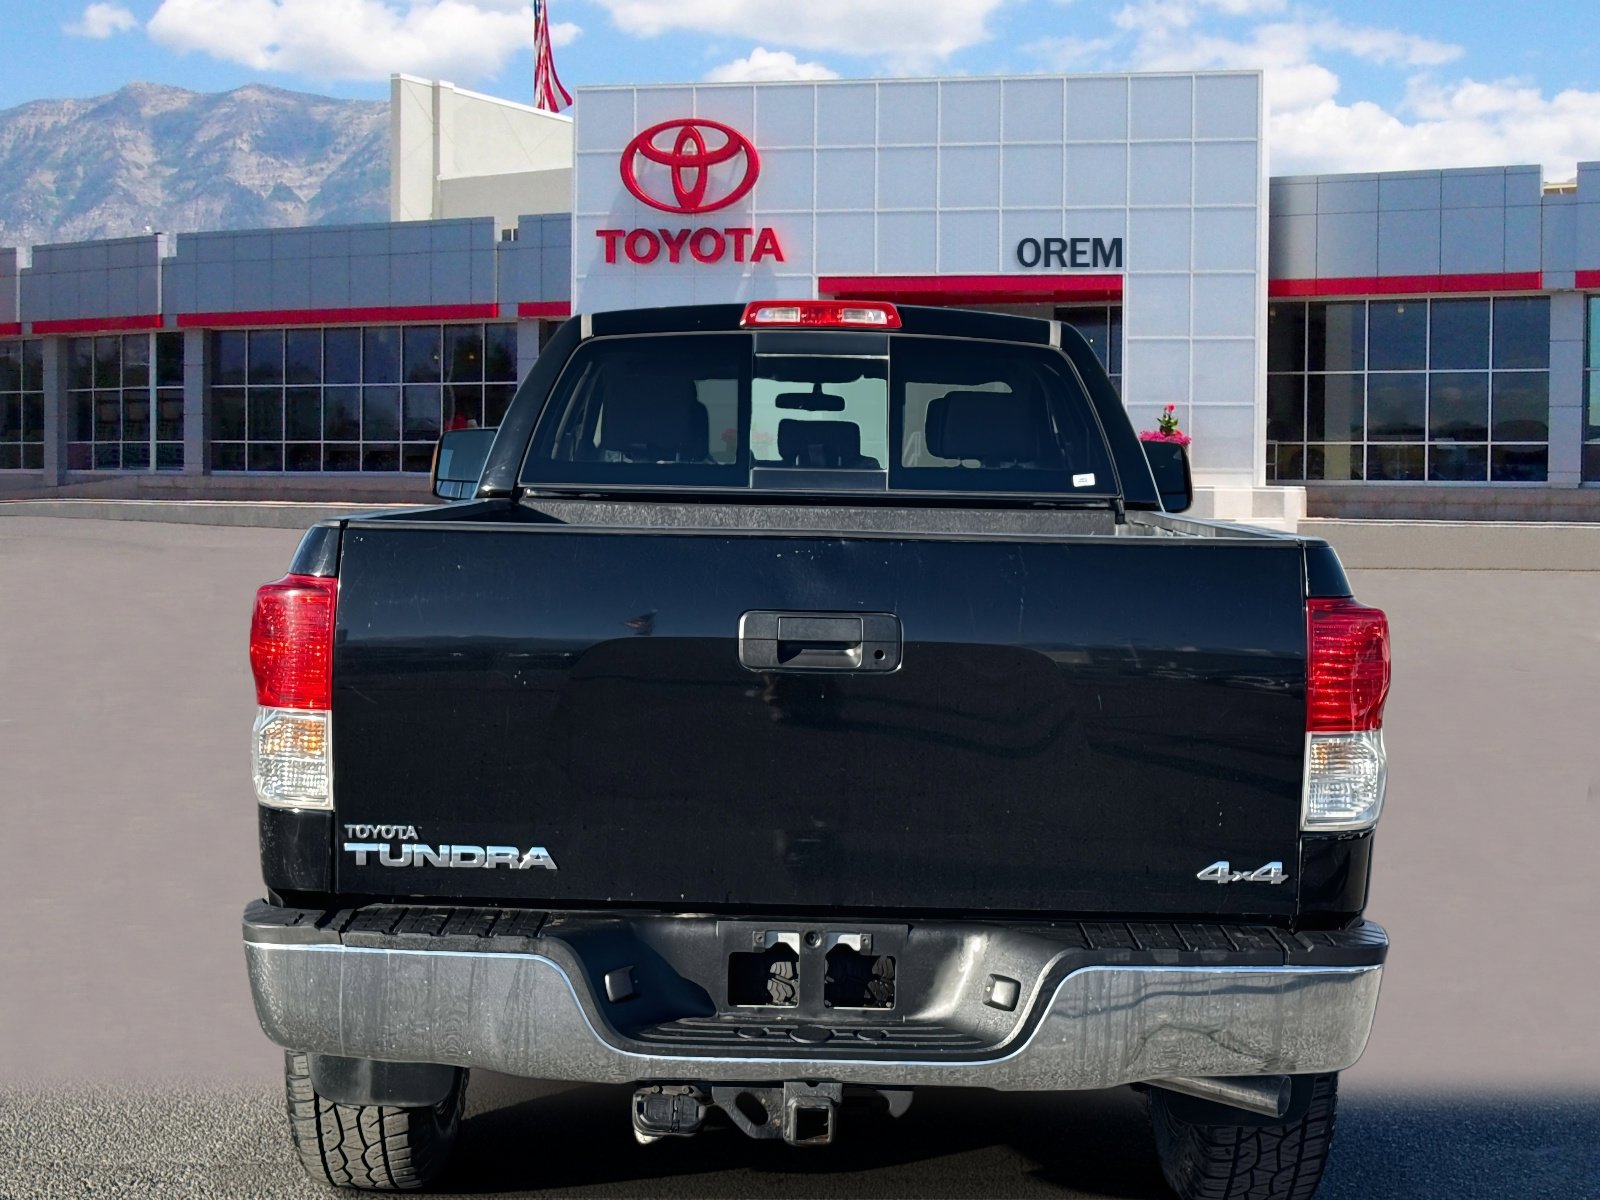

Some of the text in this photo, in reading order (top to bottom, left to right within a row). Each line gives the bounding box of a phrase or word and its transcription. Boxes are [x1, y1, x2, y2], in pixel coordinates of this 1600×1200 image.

[596, 227, 784, 264] TOYOTA
[1017, 237, 1123, 268] OREM
[344, 824, 418, 840] TOYOTA
[344, 842, 558, 870] TUNDRA
[1196, 861, 1289, 885] 4x4
